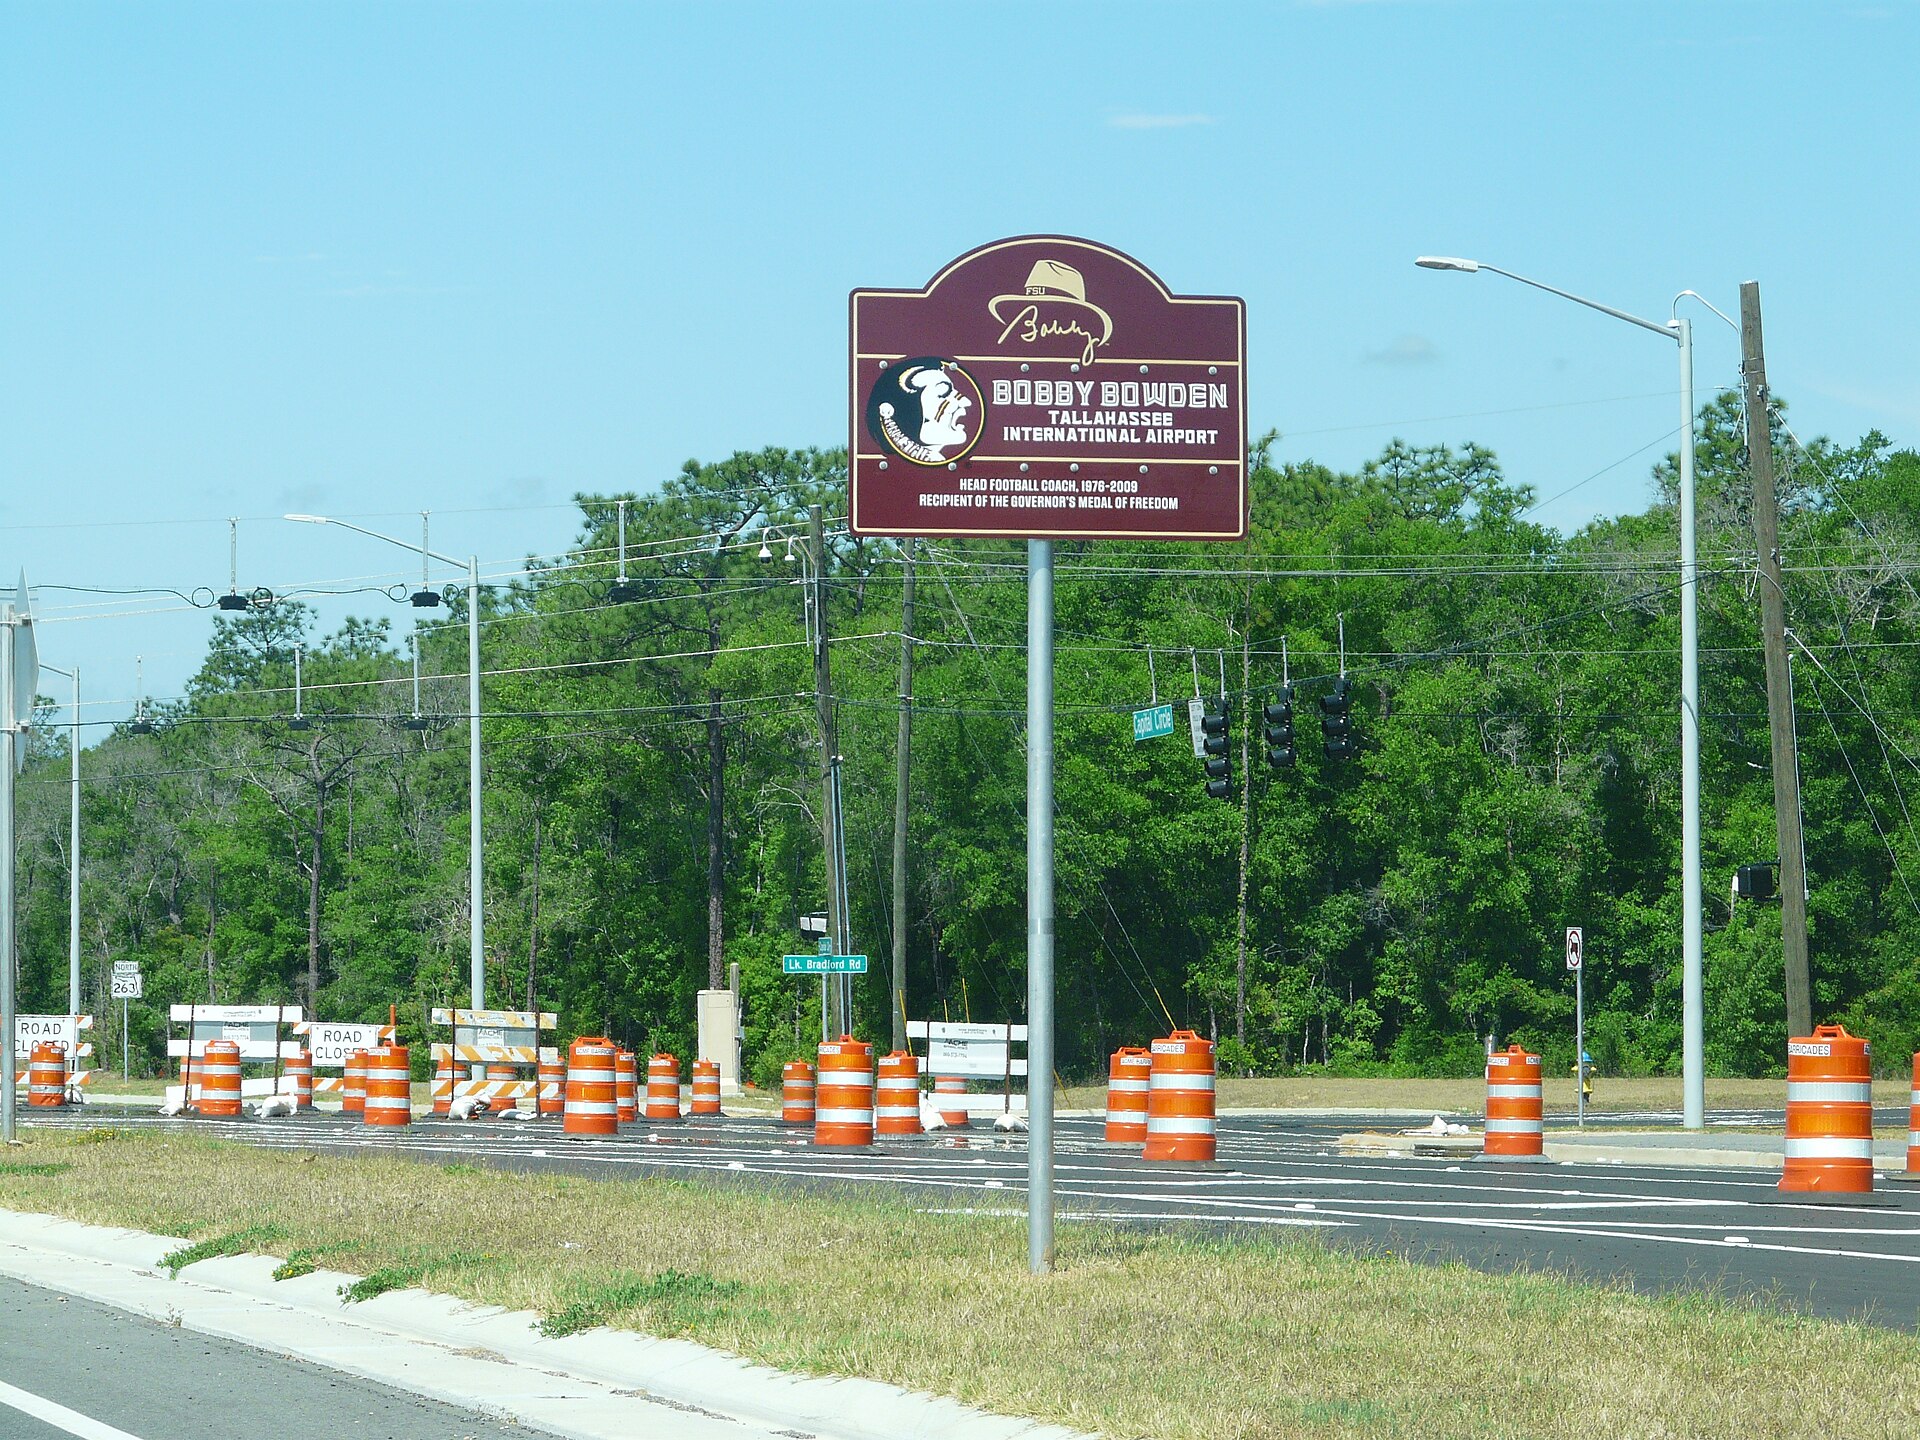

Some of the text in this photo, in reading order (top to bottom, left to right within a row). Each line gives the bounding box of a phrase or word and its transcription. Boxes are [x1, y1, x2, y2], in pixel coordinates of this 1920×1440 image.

[1025, 287, 1046, 295] FSU
[991, 379, 1228, 408] BOBBY BOWDEN
[1047, 410, 1173, 426] TALLAHASSEE
[1003, 426, 1218, 444] INTERNATIONAL AIRPORT
[959, 478, 1138, 493] HEAD FOOTBALL COACH, 1976-2009
[919, 494, 1178, 510] RECIPIENT OF THE GOVERNOR'S MEDAL OF FREEDOM
[1154, 708, 1171, 730] Circle
[788, 959, 861, 970] Lk. Bradford Rd
[114, 983, 135, 993] 263
[21, 1023, 62, 1035] ROAD
[324, 1030, 362, 1042] ROAD
